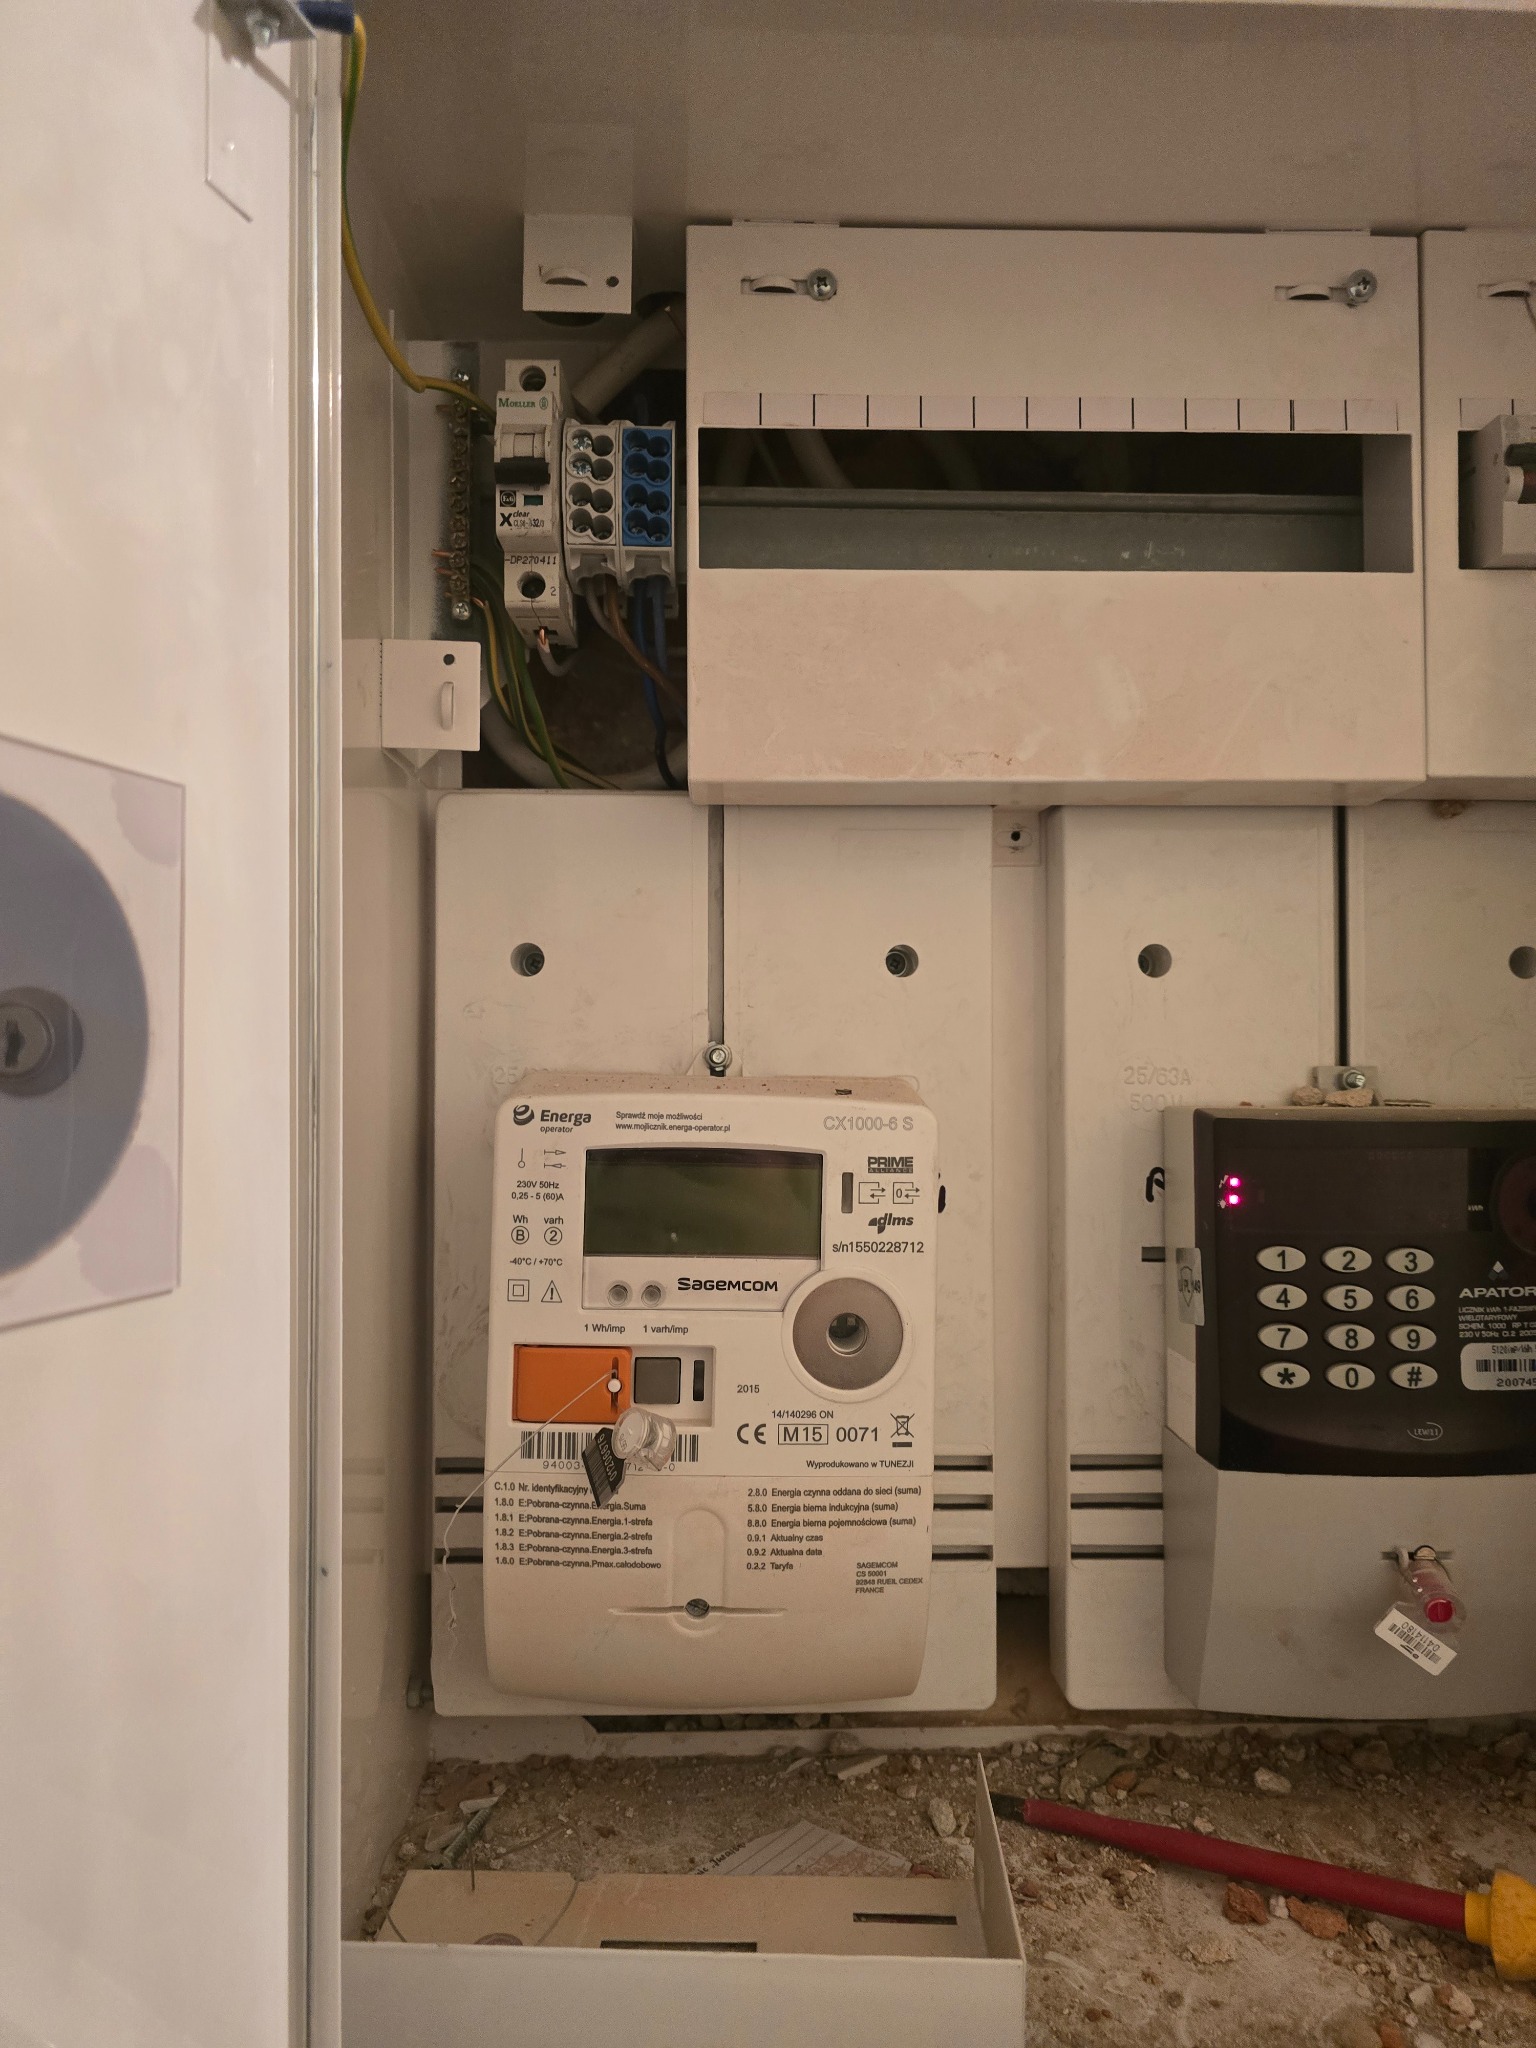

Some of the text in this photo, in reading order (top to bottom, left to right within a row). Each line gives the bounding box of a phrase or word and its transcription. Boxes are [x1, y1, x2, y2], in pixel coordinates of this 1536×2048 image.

[553, 366, 557, 376] 1
[550, 586, 557, 596] 2
[1124, 1065, 1192, 1086] 25/63A
[540, 1110, 592, 1127] Energa
[616, 1111, 646, 1121] Sprawdź
[648, 1112, 665, 1121] moje
[823, 1115, 914, 1131] CX1000-6 S
[540, 1126, 573, 1134] operator
[868, 1156, 914, 1167] PRIME
[516, 1181, 560, 1189] 230V 50Hz
[511, 1192, 529, 1201] 0,25
[536, 1193, 541, 1201] 5
[542, 1192, 564, 1202] (60)A
[513, 1215, 529, 1224] Wh
[544, 1216, 564, 1224] varh
[516, 1230, 525, 1241] B
[549, 1230, 558, 1241] 2
[832, 1241, 925, 1253] s/n1550228712
[509, 1257, 563, 1267] -40°C / +70°C
[1276, 1249, 1286, 1270] 1
[1342, 1250, 1356, 1271] 2
[1404, 1251, 1418, 1272] 3
[1276, 1287, 1291, 1308] 4
[1459, 1286, 1536, 1298] APATOR
[1343, 1289, 1357, 1309] 5
[1405, 1289, 1419, 1309] 6
[584, 1324, 626, 1334] 1 Wh/imp
[643, 1324, 689, 1335] 1 varh/imp
[1277, 1327, 1291, 1348] 7
[1345, 1328, 1359, 1349] 8
[1406, 1329, 1420, 1349] 9
[1345, 1367, 1359, 1388] 0
[1407, 1366, 1422, 1387] #
[737, 1384, 760, 1394] 2015
[772, 1409, 834, 1419] 14/140296 ON
[736, 1423, 767, 1445] CE
[836, 1427, 878, 1442] 0071
[806, 1460, 869, 1469] Wyprodukowano
[879, 1460, 914, 1468] TUNEZJI
[494, 1482, 515, 1491] C.1.0
[518, 1483, 530, 1492] Nr.
[532, 1483, 588, 1496] identyfikacyjny
[747, 1486, 921, 1498] 2.8.0 Energia czynna oddana do sieci (suma)
[495, 1498, 647, 1511] 1.8.0 E:Pobrana-czynna.Ergia.Suma
[747, 1502, 898, 1513] 5.8.0 Energia bierna indukcyjna (suma)
[495, 1513, 514, 1522] 1.8.1
[747, 1516, 917, 1529] 8.8.0 Energia bierna pojemnościowa (suma)
[495, 1528, 514, 1537] 1.8.2
[747, 1534, 766, 1542] 0.9.1
[770, 1533, 804, 1543] Aktualny
[495, 1542, 514, 1551] 1.8.3
[746, 1548, 823, 1556] 0.9.2 Aktualna data
[496, 1557, 515, 1565] 1.6.0
[770, 1562, 794, 1572] Taryfa
